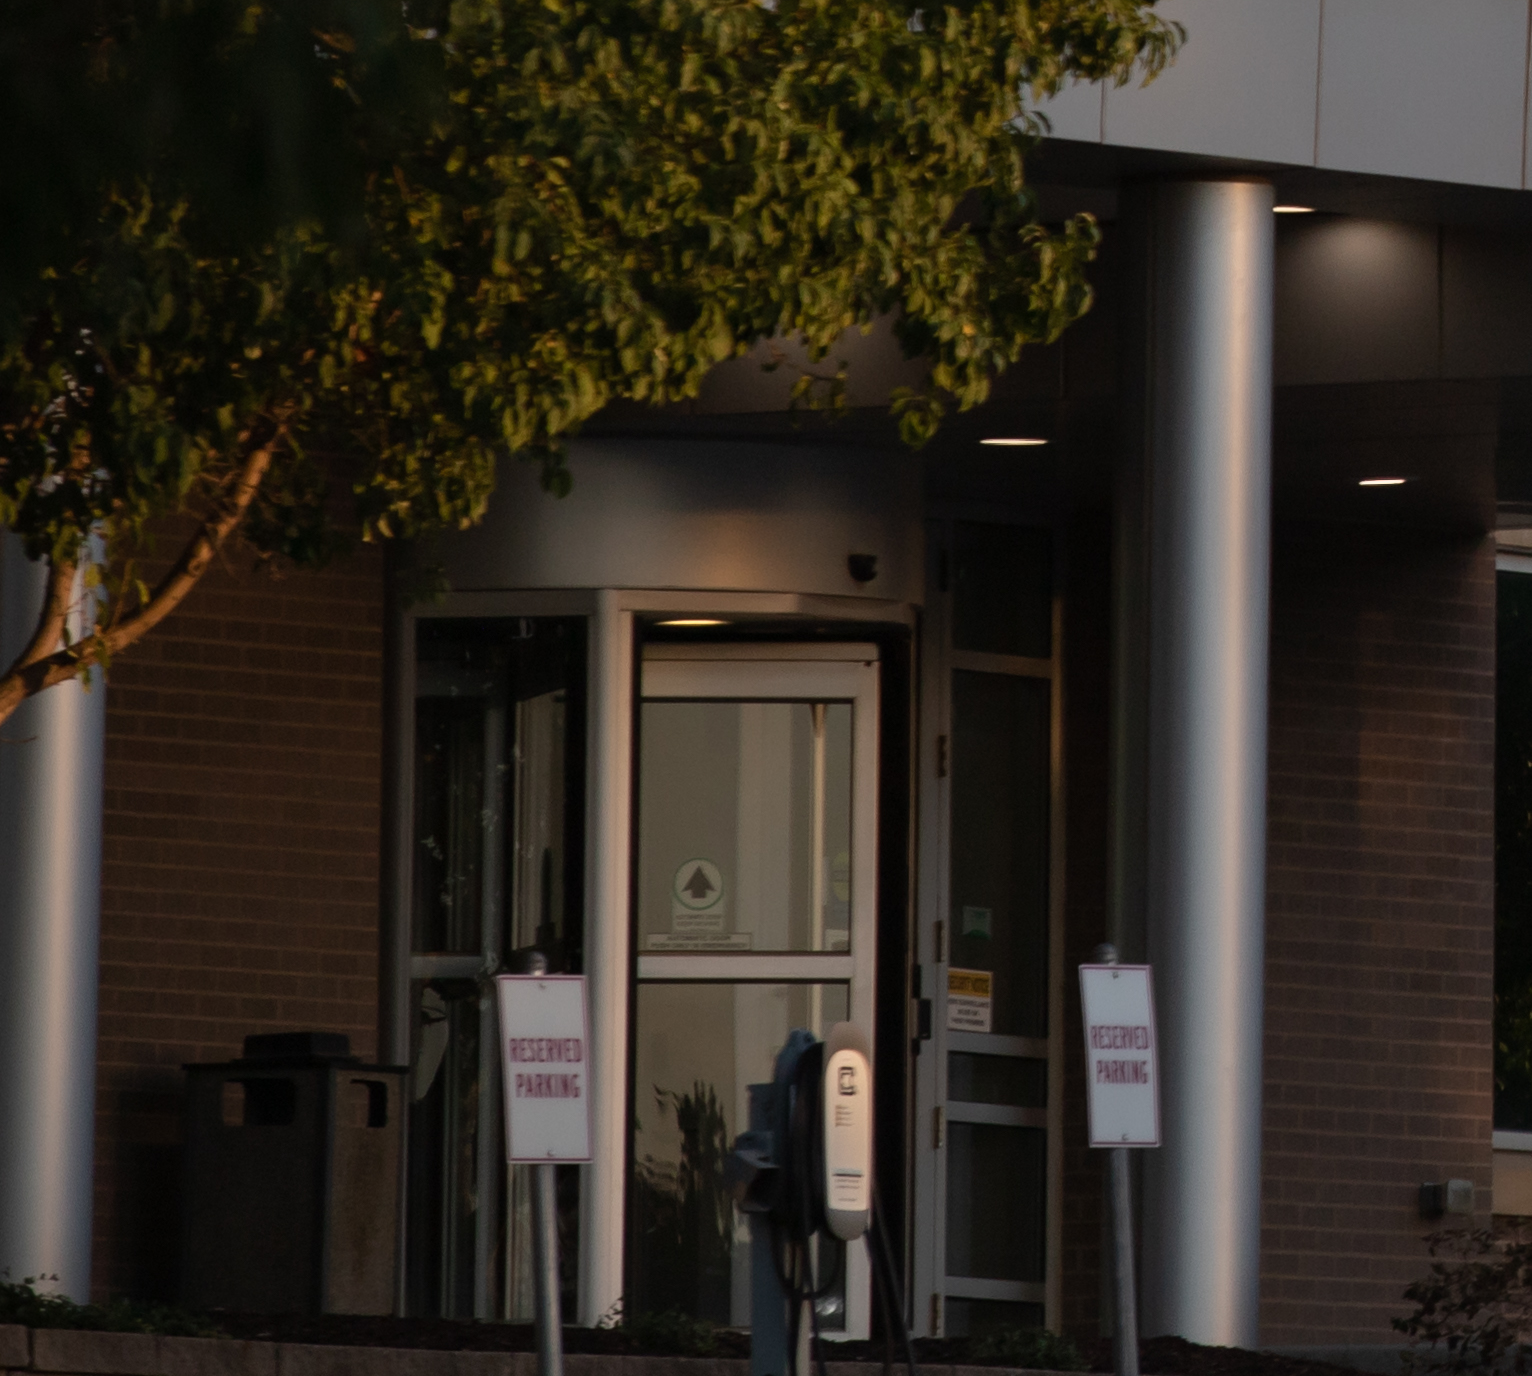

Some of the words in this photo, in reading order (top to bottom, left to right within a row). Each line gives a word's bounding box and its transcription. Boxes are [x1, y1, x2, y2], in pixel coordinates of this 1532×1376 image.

[1091, 1025, 1149, 1049] RESERVED
[509, 1038, 583, 1063] RESERVED
[1096, 1060, 1148, 1084] PARKING
[515, 1074, 581, 1098] PARKING
